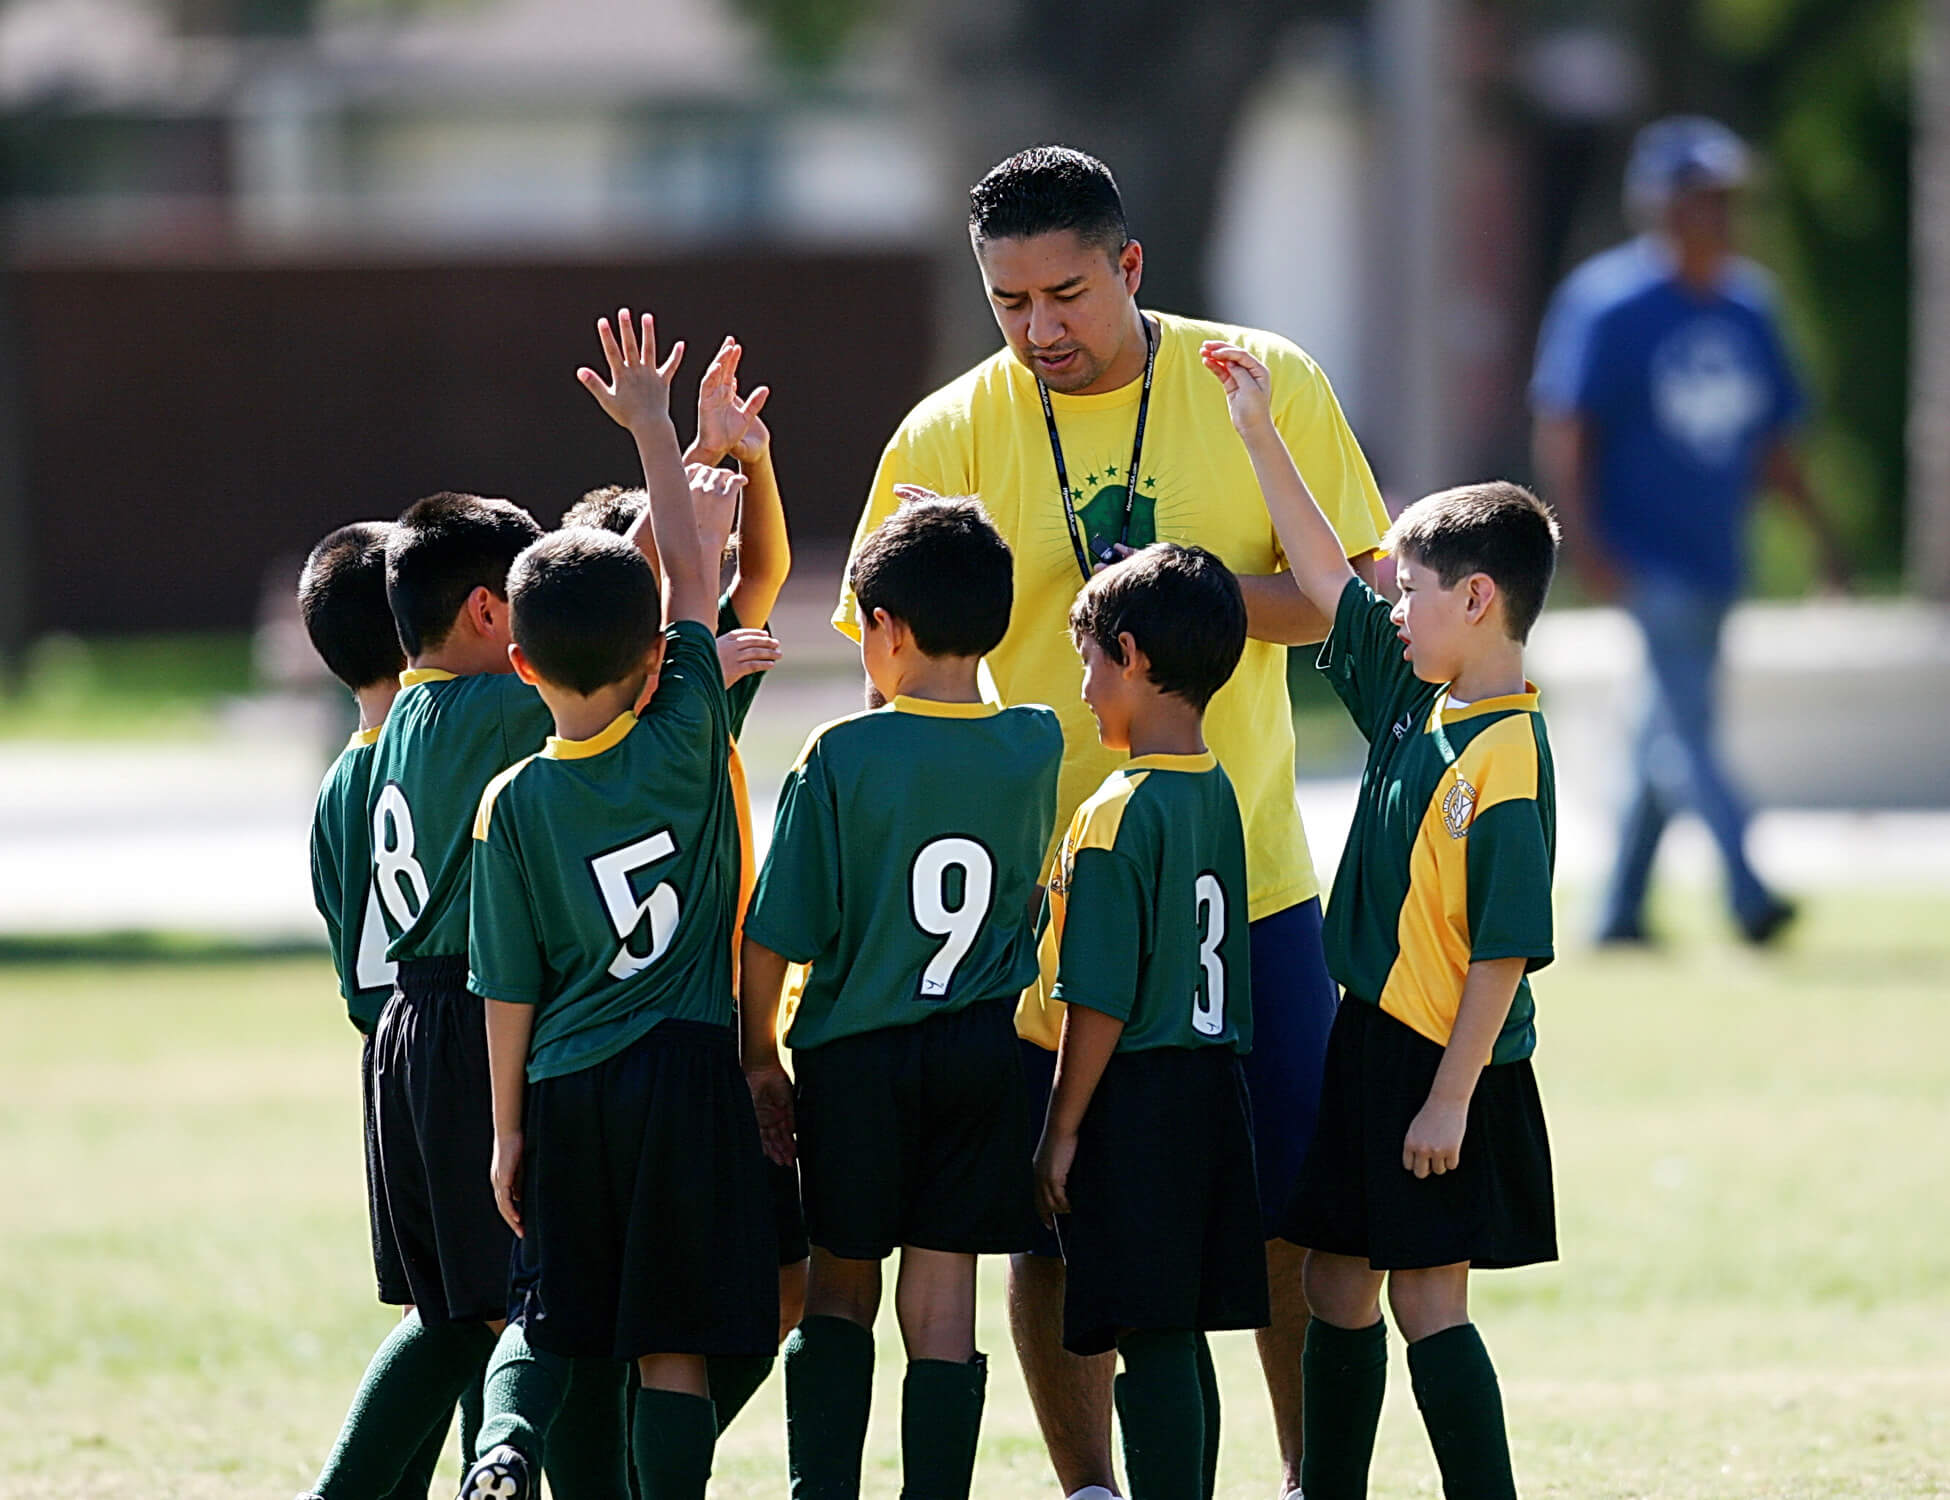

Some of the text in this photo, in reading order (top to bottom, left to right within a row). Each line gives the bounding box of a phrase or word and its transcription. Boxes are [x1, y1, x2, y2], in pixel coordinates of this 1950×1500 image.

[373, 783, 431, 934] 8
[591, 830, 680, 980] 5
[911, 837, 994, 996] 9
[1191, 874, 1226, 1036] 3
